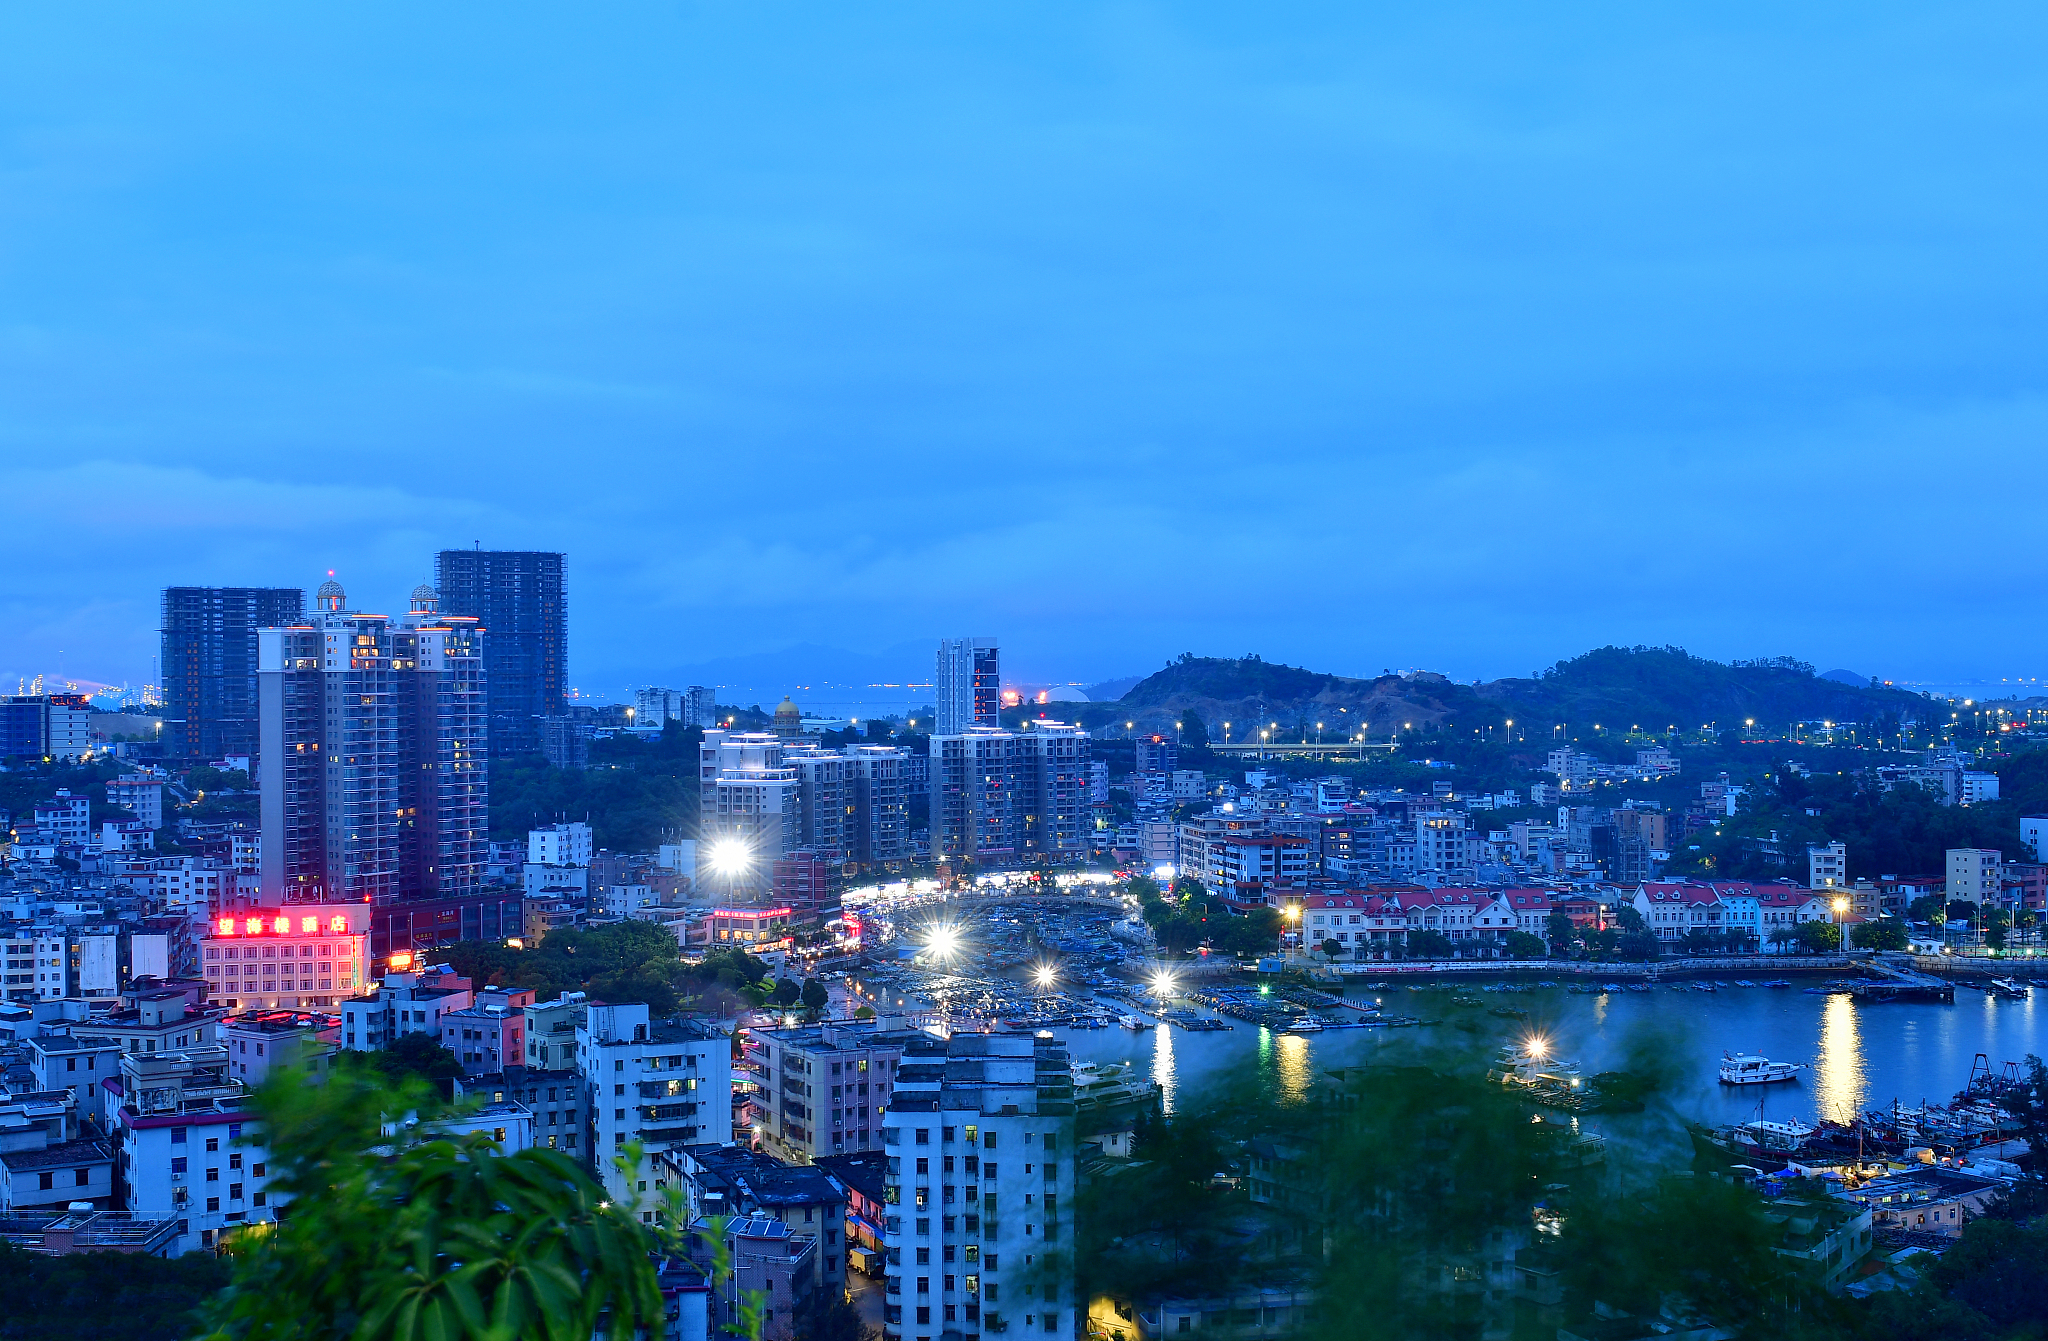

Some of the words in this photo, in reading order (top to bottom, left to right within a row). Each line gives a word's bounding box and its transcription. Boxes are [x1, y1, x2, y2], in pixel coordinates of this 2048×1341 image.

[219, 915, 347, 935] 望海楼酒店
